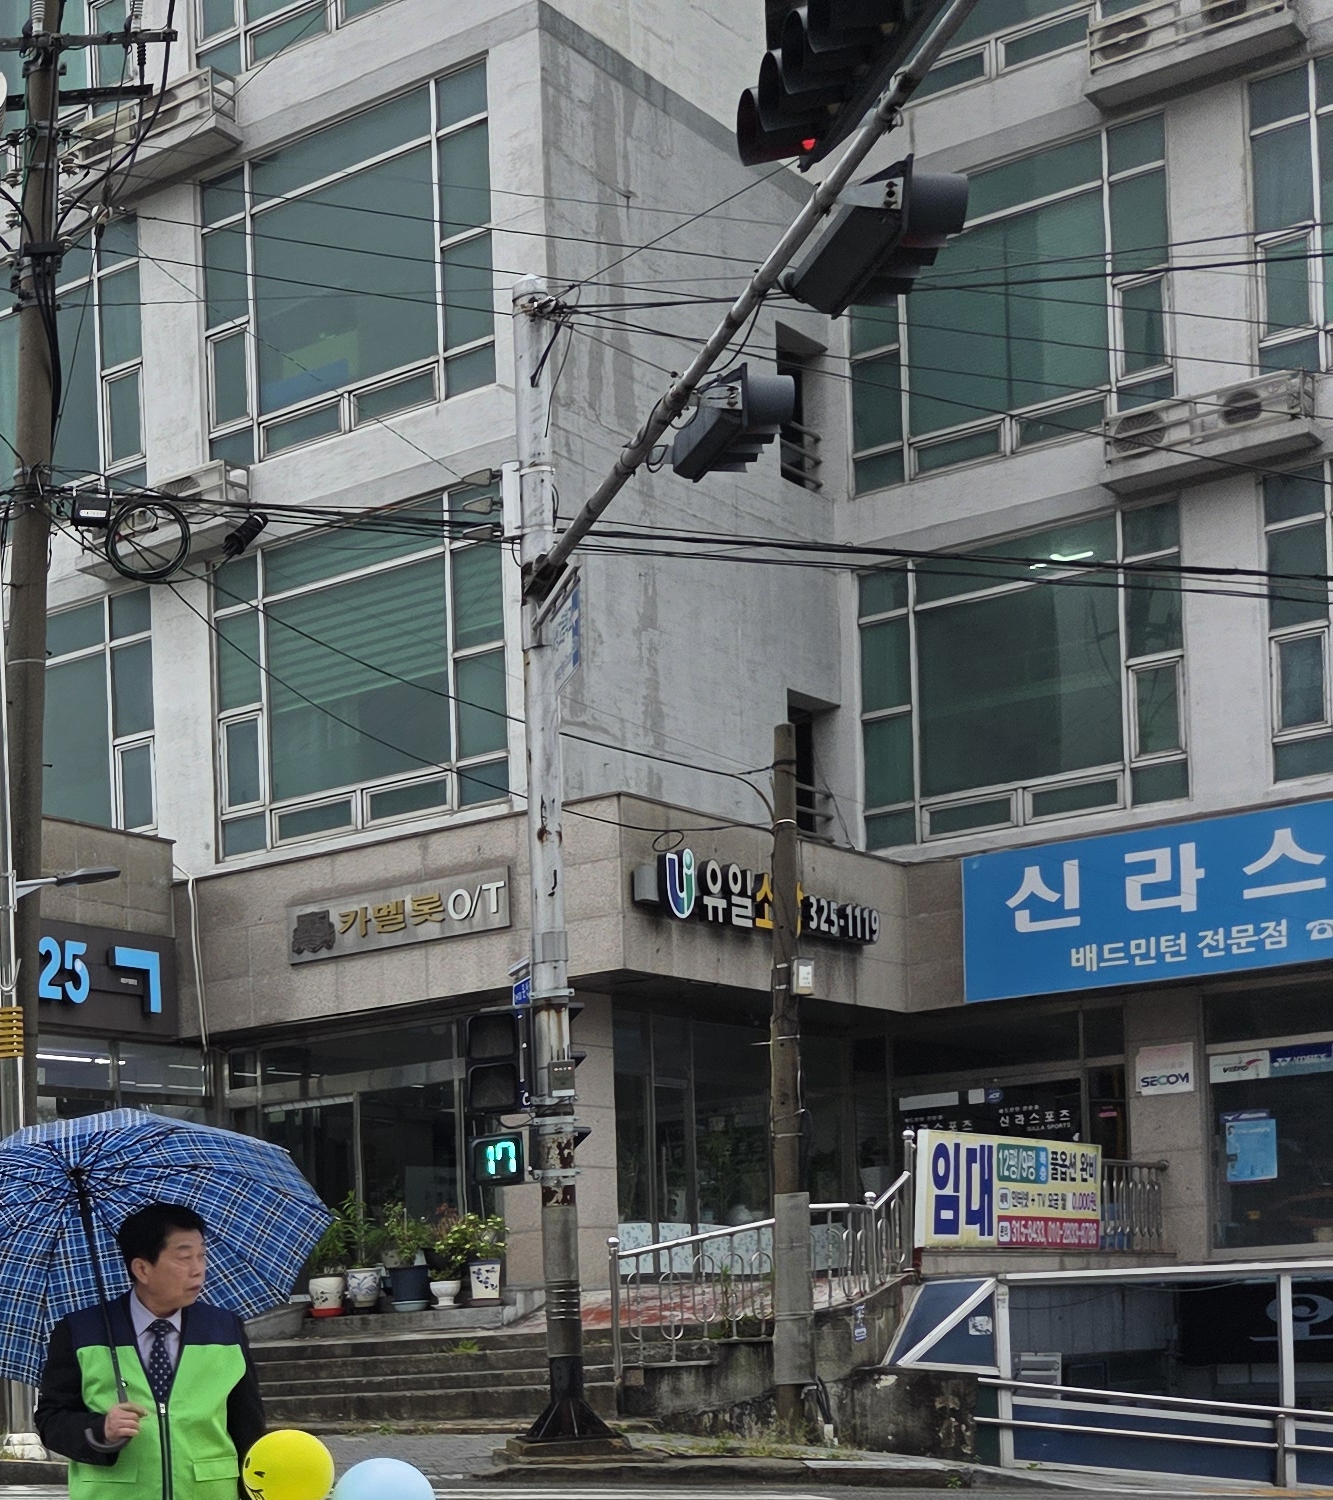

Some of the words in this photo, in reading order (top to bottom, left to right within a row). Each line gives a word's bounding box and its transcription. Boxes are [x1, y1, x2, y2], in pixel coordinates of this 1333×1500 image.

[706, 859, 804, 939] 유일소
[809, 894, 881, 943] 325-1119
[1071, 933, 1187, 972] 배드민턴
[1197, 918, 1288, 958] 전문점
[1140, 1072, 1190, 1088] SECOM
[487, 1141, 517, 1175] 17
[998, 1148, 1036, 1181] 12평/9평
[1050, 1150, 1077, 1182] 풀옵션
[931, 1142, 994, 1237] 임대
